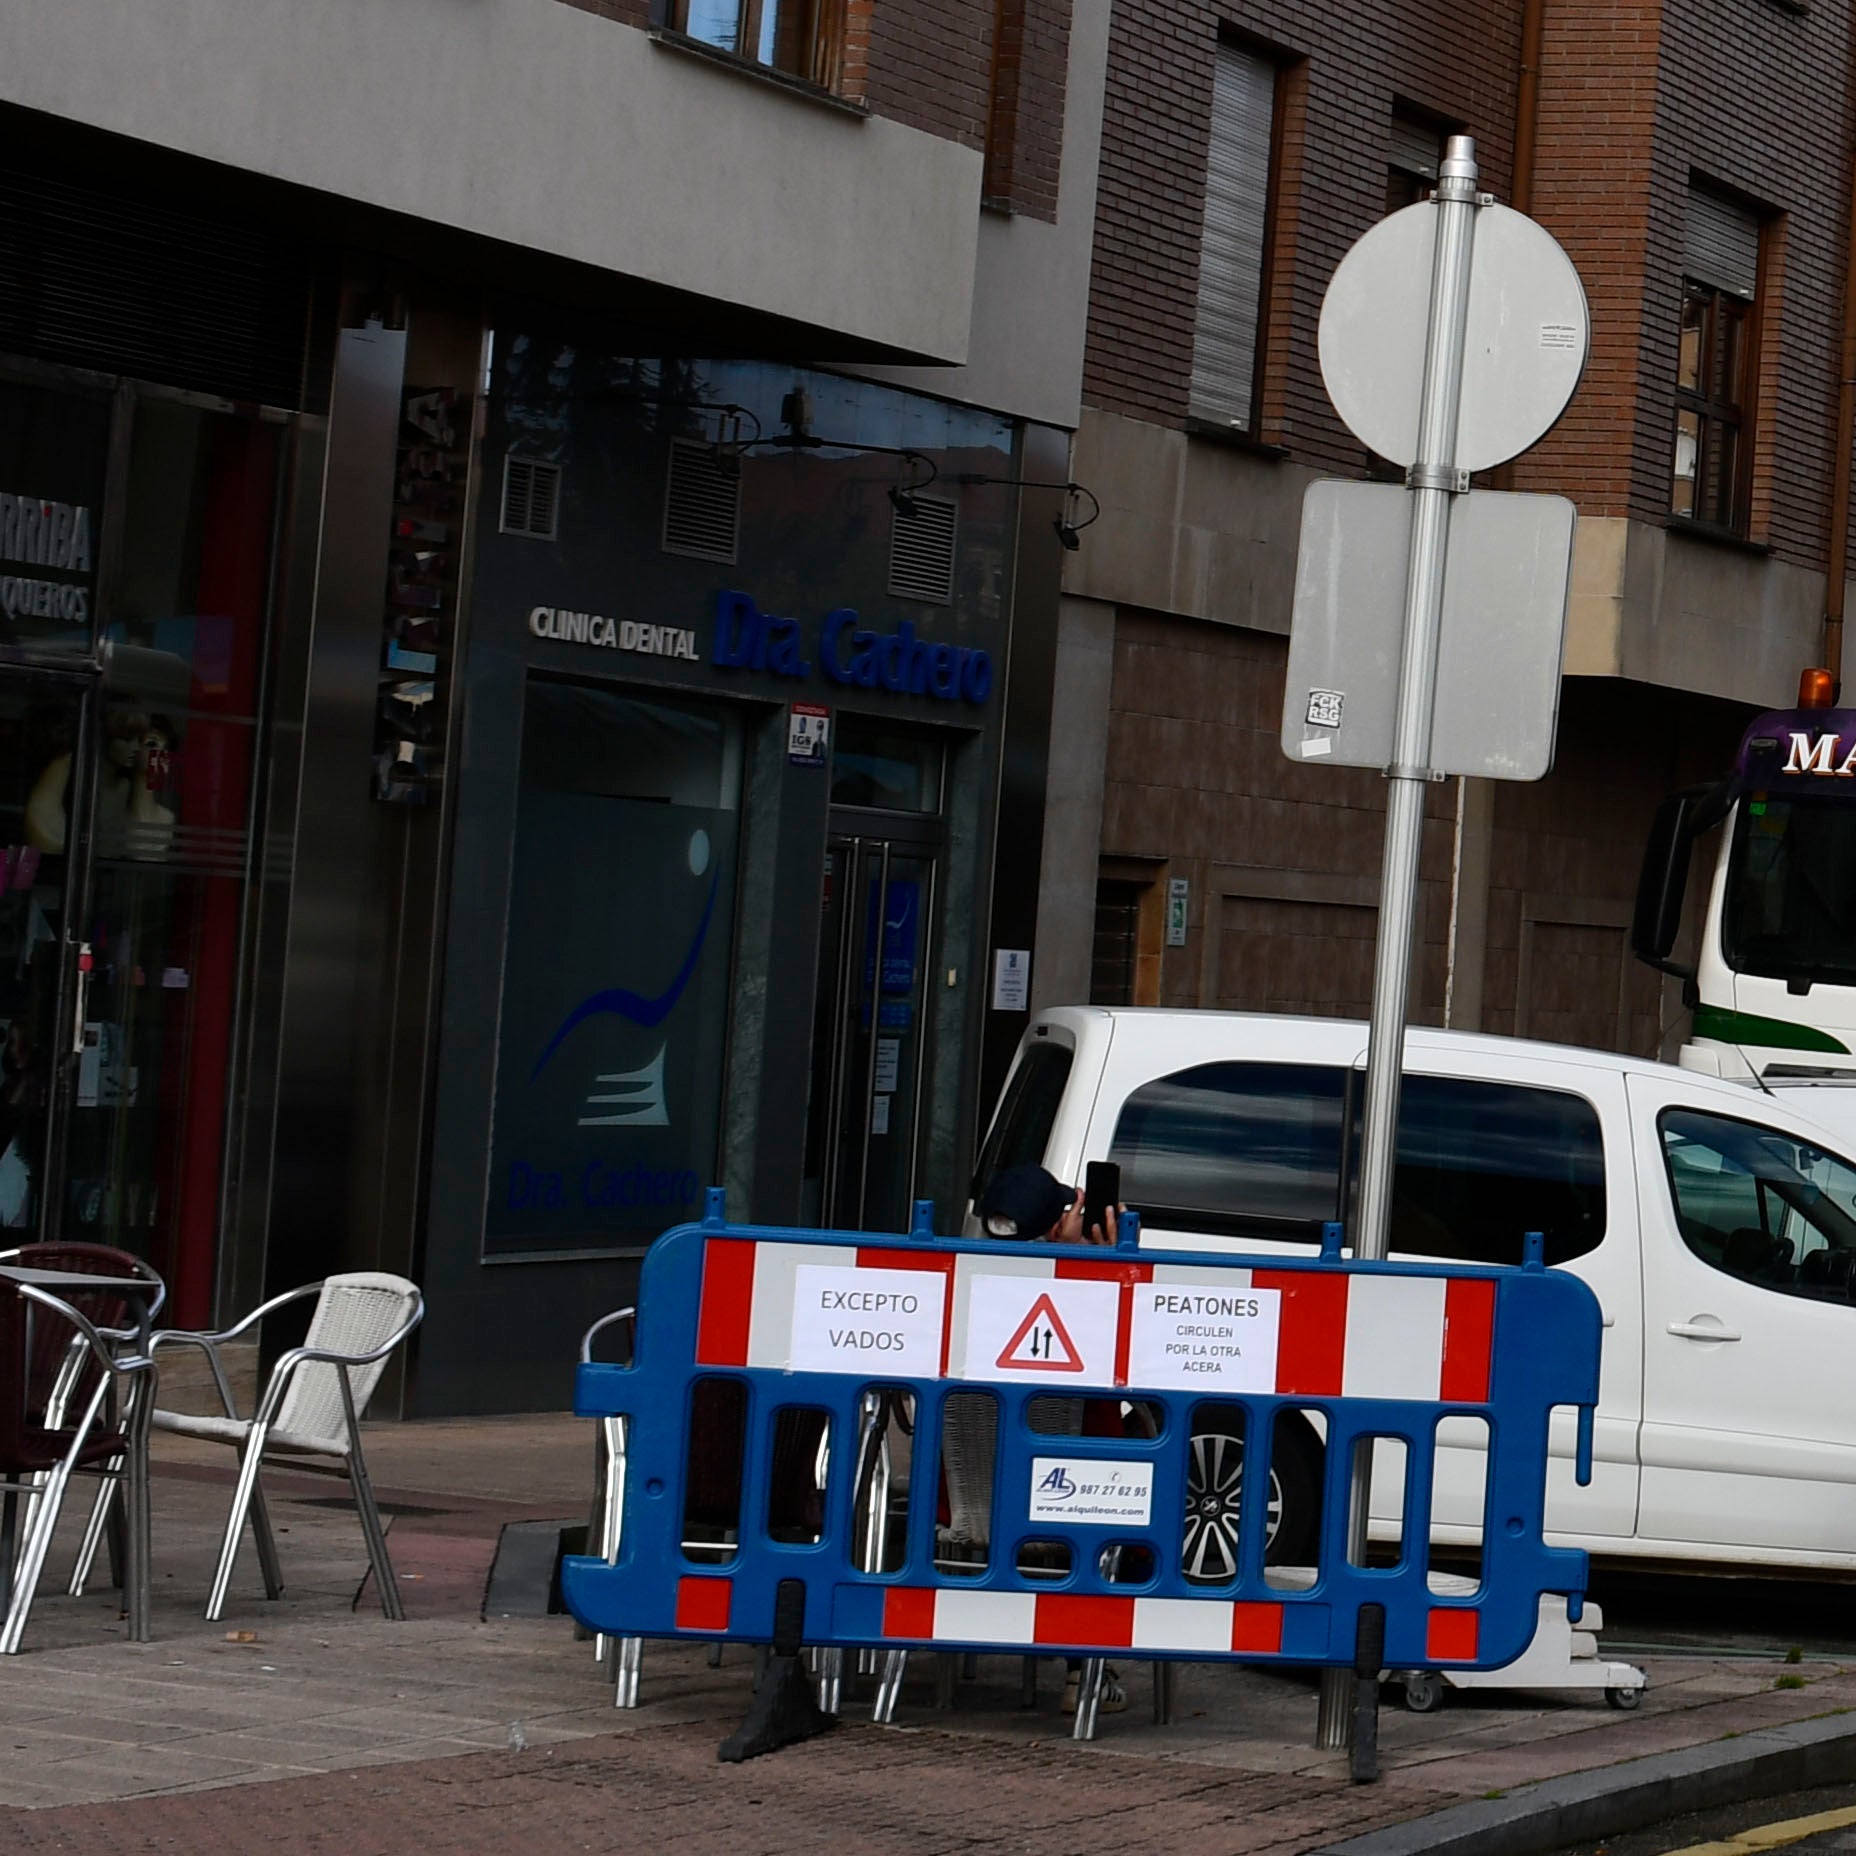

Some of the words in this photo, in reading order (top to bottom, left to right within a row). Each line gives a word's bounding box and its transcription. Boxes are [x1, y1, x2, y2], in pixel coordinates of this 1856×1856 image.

[529, 606, 618, 649] CLINICA
[620, 621, 701, 662] DENTAL
[712, 588, 811, 678] Dra.
[819, 608, 993, 705] Cachero
[1311, 694, 1342, 710] FCK
[1308, 706, 1340, 721] RSG
[508, 1160, 567, 1212] Dra.
[583, 1159, 699, 1208] Cachero
[820, 1290, 919, 1314] EXCEPTO
[1152, 1294, 1259, 1318] PEATONES
[1175, 1324, 1234, 1338] CIRCULEN
[828, 1329, 906, 1351] VADOS
[1164, 1343, 1190, 1356] POR
[1192, 1344, 1208, 1357] LA
[1210, 1345, 1242, 1358] OTRA
[1182, 1360, 1223, 1373] ACERA
[1040, 1467, 1070, 1490] AL
[1080, 1484, 1101, 1495] 987
[1101, 1485, 1116, 1496] 27
[1118, 1486, 1132, 1497] 62
[1134, 1486, 1148, 1497] 95
[1036, 1505, 1145, 1517] www.alquileon.com
